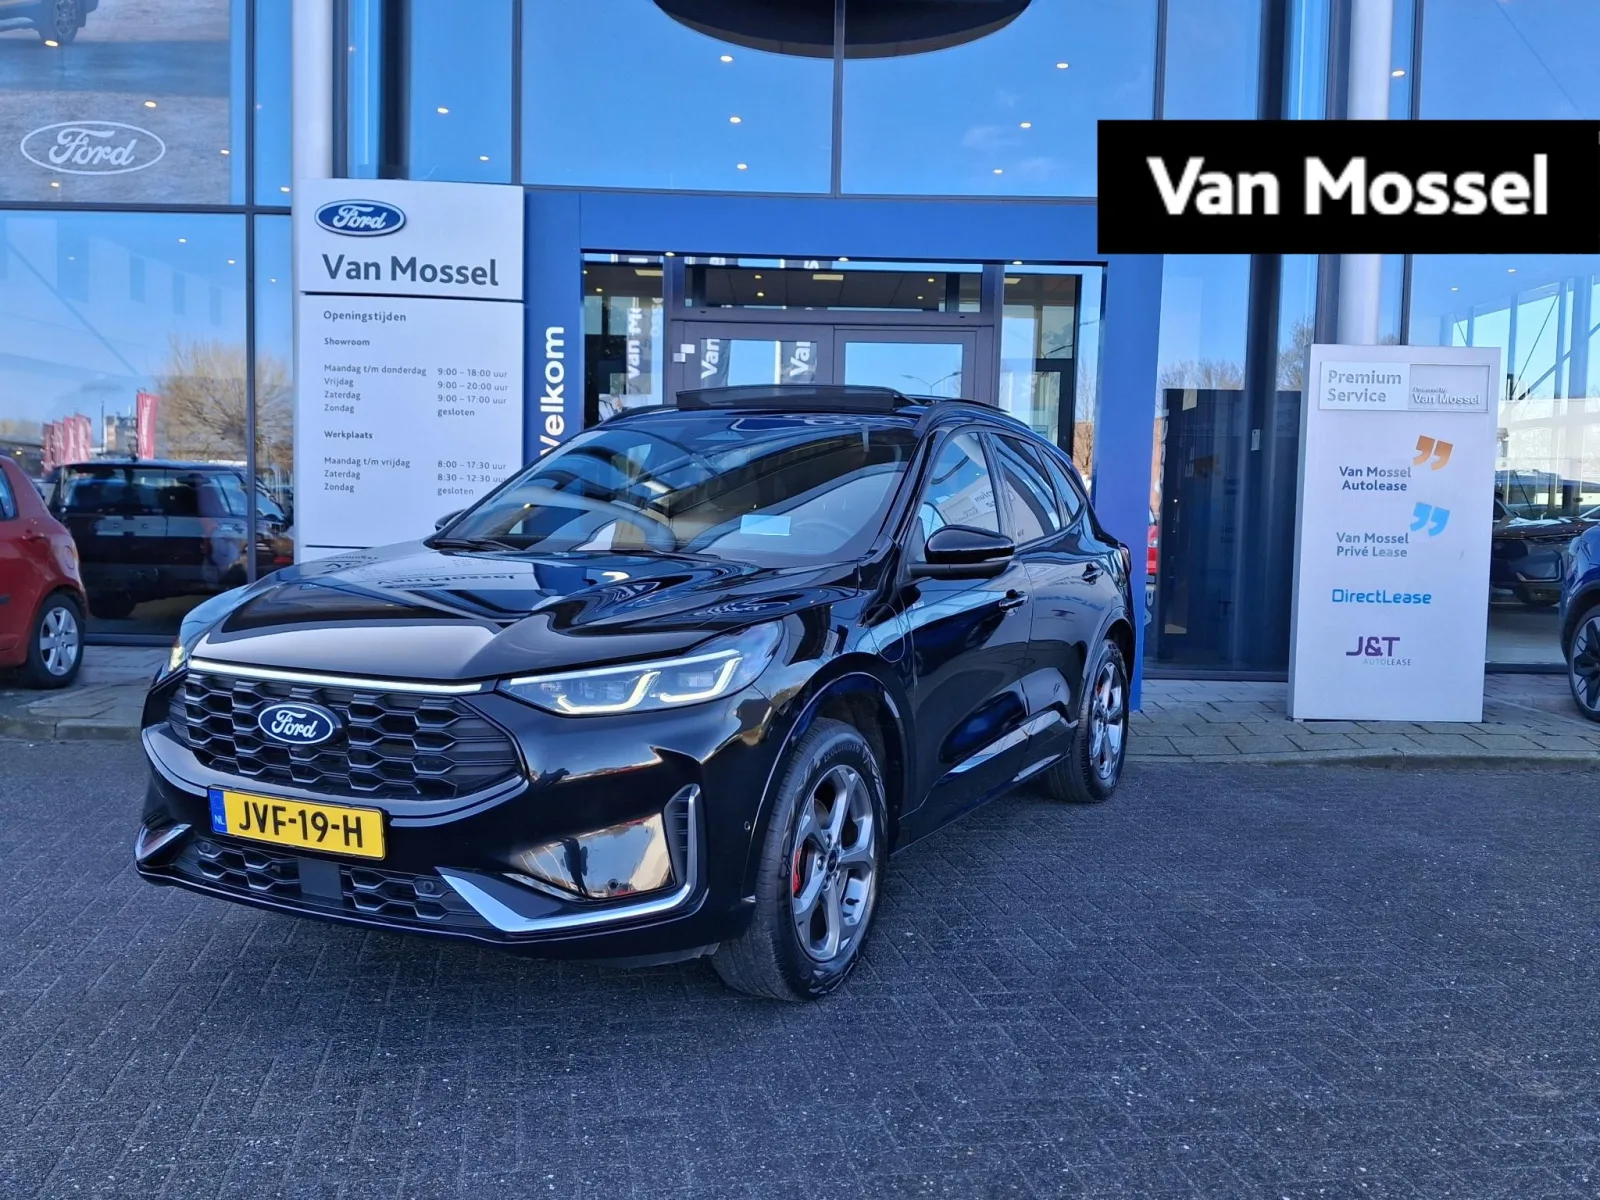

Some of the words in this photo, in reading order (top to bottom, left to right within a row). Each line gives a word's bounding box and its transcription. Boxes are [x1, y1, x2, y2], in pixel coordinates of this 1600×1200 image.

[48, 127, 138, 166] Ford
[333, 204, 387, 230] Ford
[322, 254, 381, 280] Van
[390, 256, 499, 286] Mossel
[323, 310, 407, 323] Openingstijden
[324, 337, 371, 347] Showroom
[701, 338, 720, 379] Van
[324, 364, 362, 375] Maandag
[363, 365, 379, 374] t/m
[381, 366, 427, 377] donderdag
[437, 368, 457, 376] 9:00
[467, 369, 491, 378] 18:00
[324, 377, 354, 388] Vrijdag
[1327, 369, 1402, 385] Premium
[437, 381, 457, 390] 9:00
[467, 382, 492, 391] 20:00
[494, 384, 509, 392] uur
[324, 391, 361, 401] Zaterdag
[437, 394, 457, 403] 9:00
[467, 395, 490, 404] 17:00
[1327, 388, 1387, 402] Service
[1412, 393, 1436, 404] Van
[1438, 393, 1481, 404] Mossel
[324, 404, 355, 414] Zondag
[437, 408, 475, 417] gesloten
[324, 430, 373, 440] Werkplaats
[324, 457, 362, 467] Maandag
[363, 458, 379, 466] t/m
[381, 458, 411, 469] vrijdag
[437, 460, 457, 468] 8:00
[467, 461, 490, 470] 17:30
[324, 470, 361, 480] Zaterdag
[437, 473, 457, 482] 8:30
[467, 474, 491, 482] 12:30
[1339, 466, 1363, 477] Van
[1366, 466, 1412, 478] Mossel
[324, 483, 355, 493] Zondag
[1342, 480, 1408, 491] Autolease
[437, 487, 474, 496] gesloten
[1336, 532, 1360, 543] Van
[1364, 533, 1409, 544] Mossel
[1336, 546, 1369, 557] Privé
[1372, 547, 1408, 557] Lease
[1331, 589, 1432, 604] DirectLease
[1346, 636, 1400, 657] J&T
[1362, 658, 1412, 666] AUTOLEASE
[271, 710, 318, 738] Ford
[214, 815, 226, 825] NL
[239, 800, 363, 848] JVF-19-H
